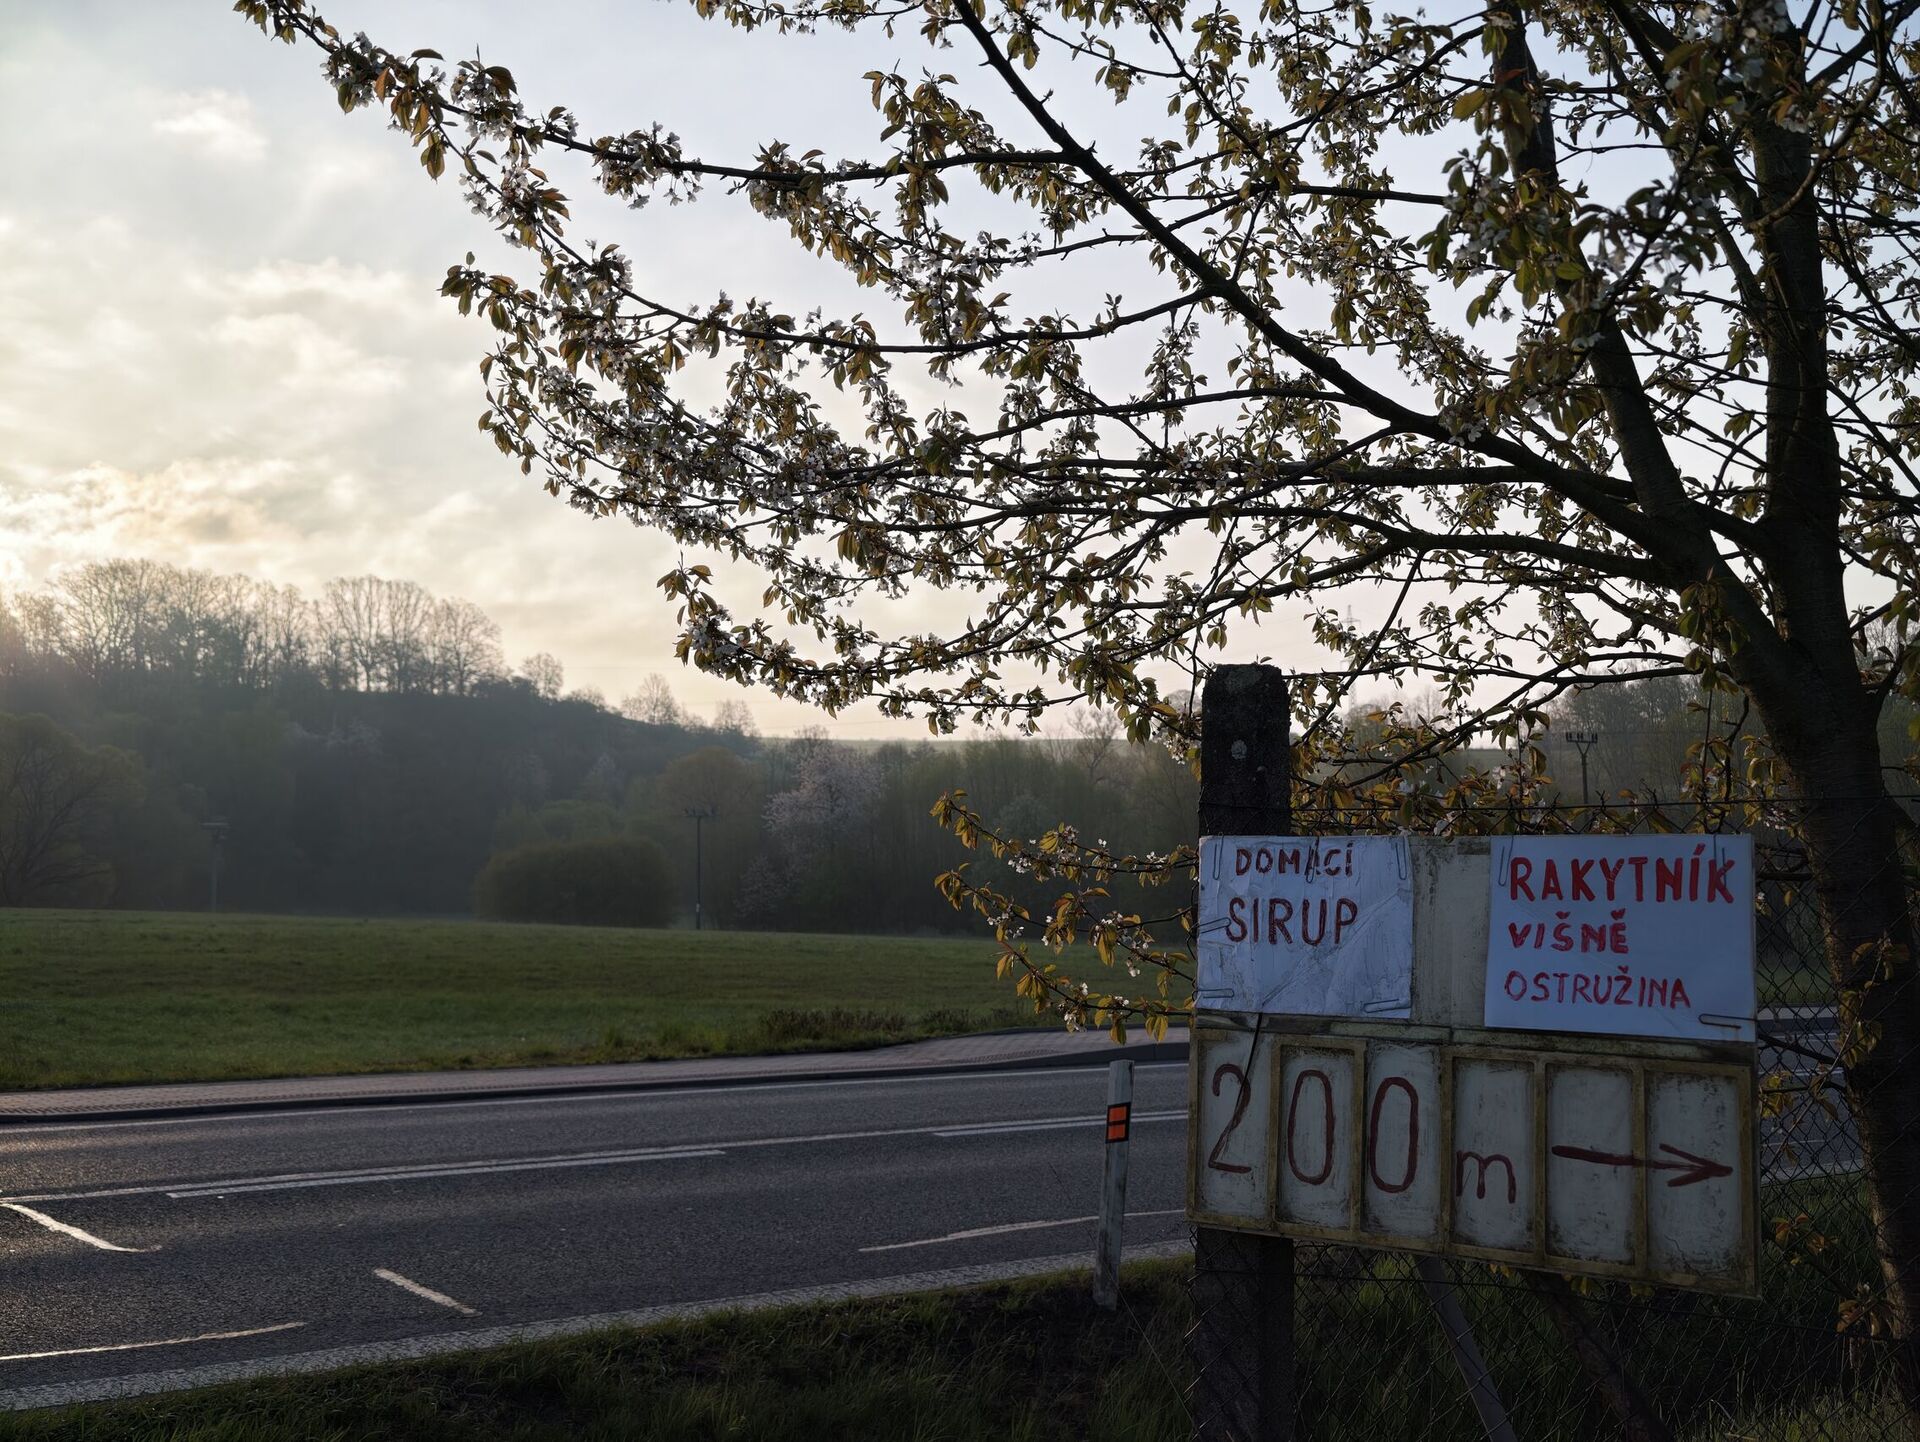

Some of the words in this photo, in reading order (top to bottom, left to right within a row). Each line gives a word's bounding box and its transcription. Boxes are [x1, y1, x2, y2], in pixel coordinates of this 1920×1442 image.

[1510, 843, 1735, 903] RAKYTNÍK
[1226, 897, 1358, 945] SIRUP
[1508, 908, 1629, 954] VIŠNĚ
[1504, 965, 1691, 1009] OSTRUŽINA
[1207, 1063, 1419, 1194] 200
[1455, 1150, 1517, 1204] m
